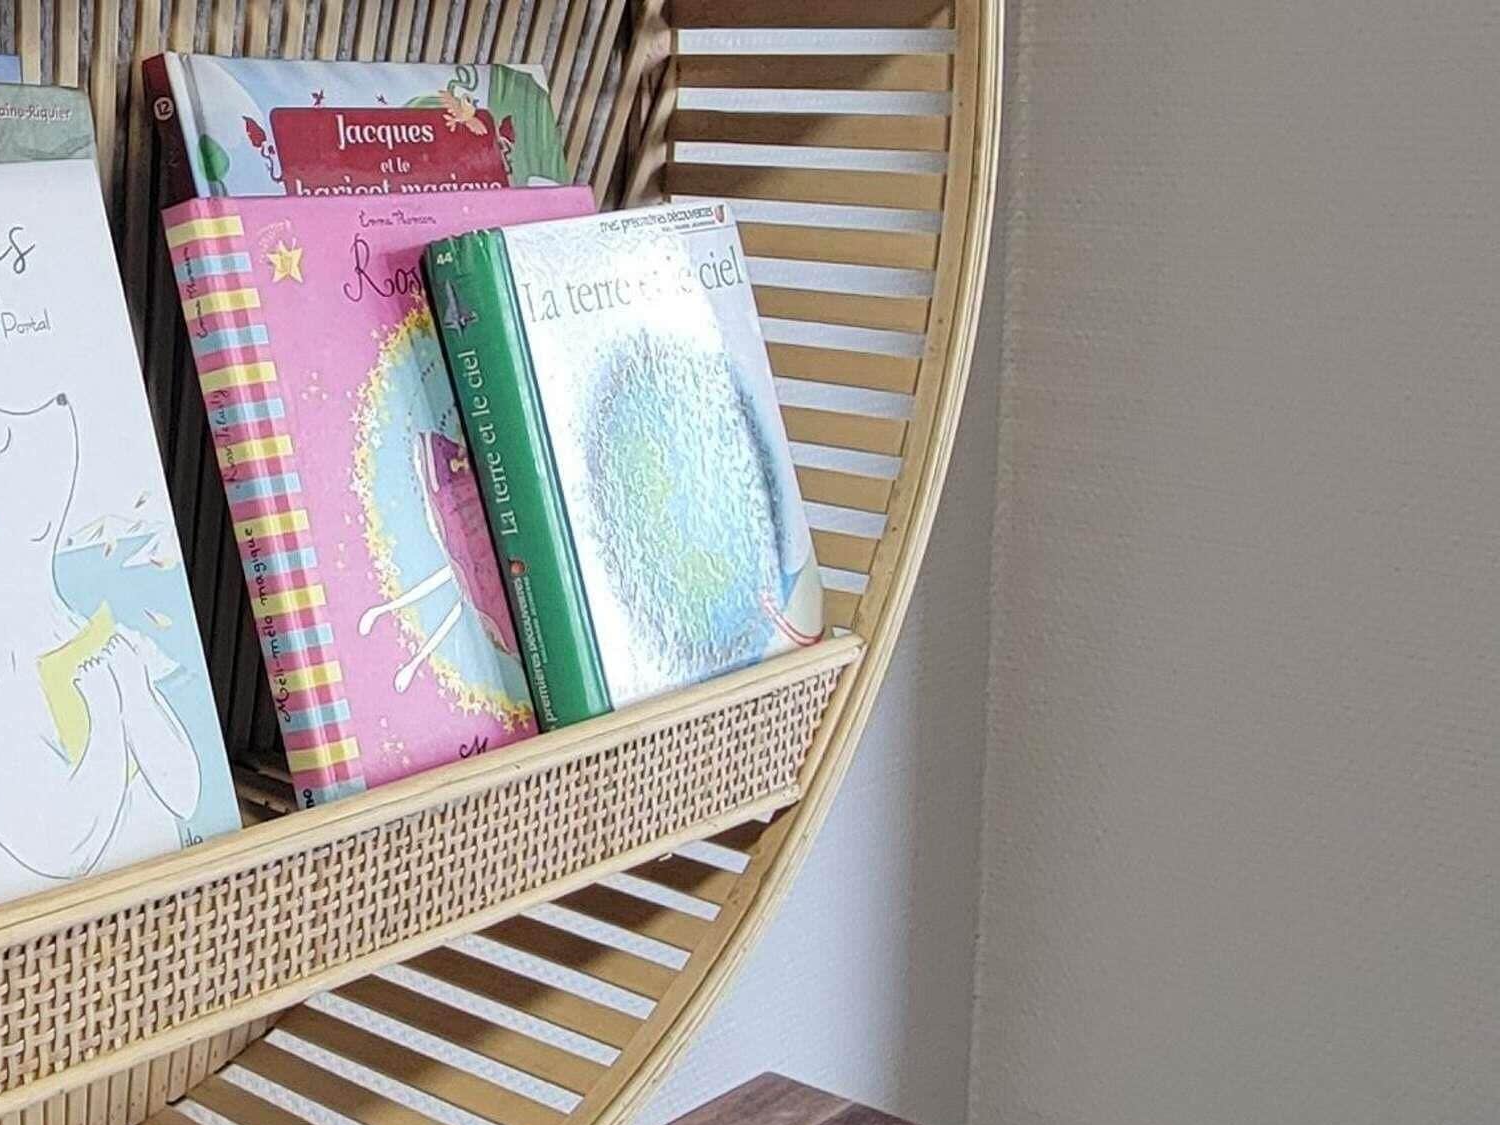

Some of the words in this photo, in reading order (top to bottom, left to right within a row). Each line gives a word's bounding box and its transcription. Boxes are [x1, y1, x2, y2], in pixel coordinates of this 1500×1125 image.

[157, 100, 171, 116] 12
[335, 113, 434, 150] Jacques
[380, 157, 393, 174] et
[397, 156, 410, 173] le
[436, 251, 453, 265] 44
[699, 245, 744, 290] ciel
[522, 282, 560, 322] La
[0, 308, 51, 340] Portal
[457, 348, 483, 389] ciel
[471, 395, 490, 417] le
[478, 422, 496, 445] et
[483, 451, 511, 504] terre
[499, 510, 519, 536] La
[243, 527, 269, 607] magique
